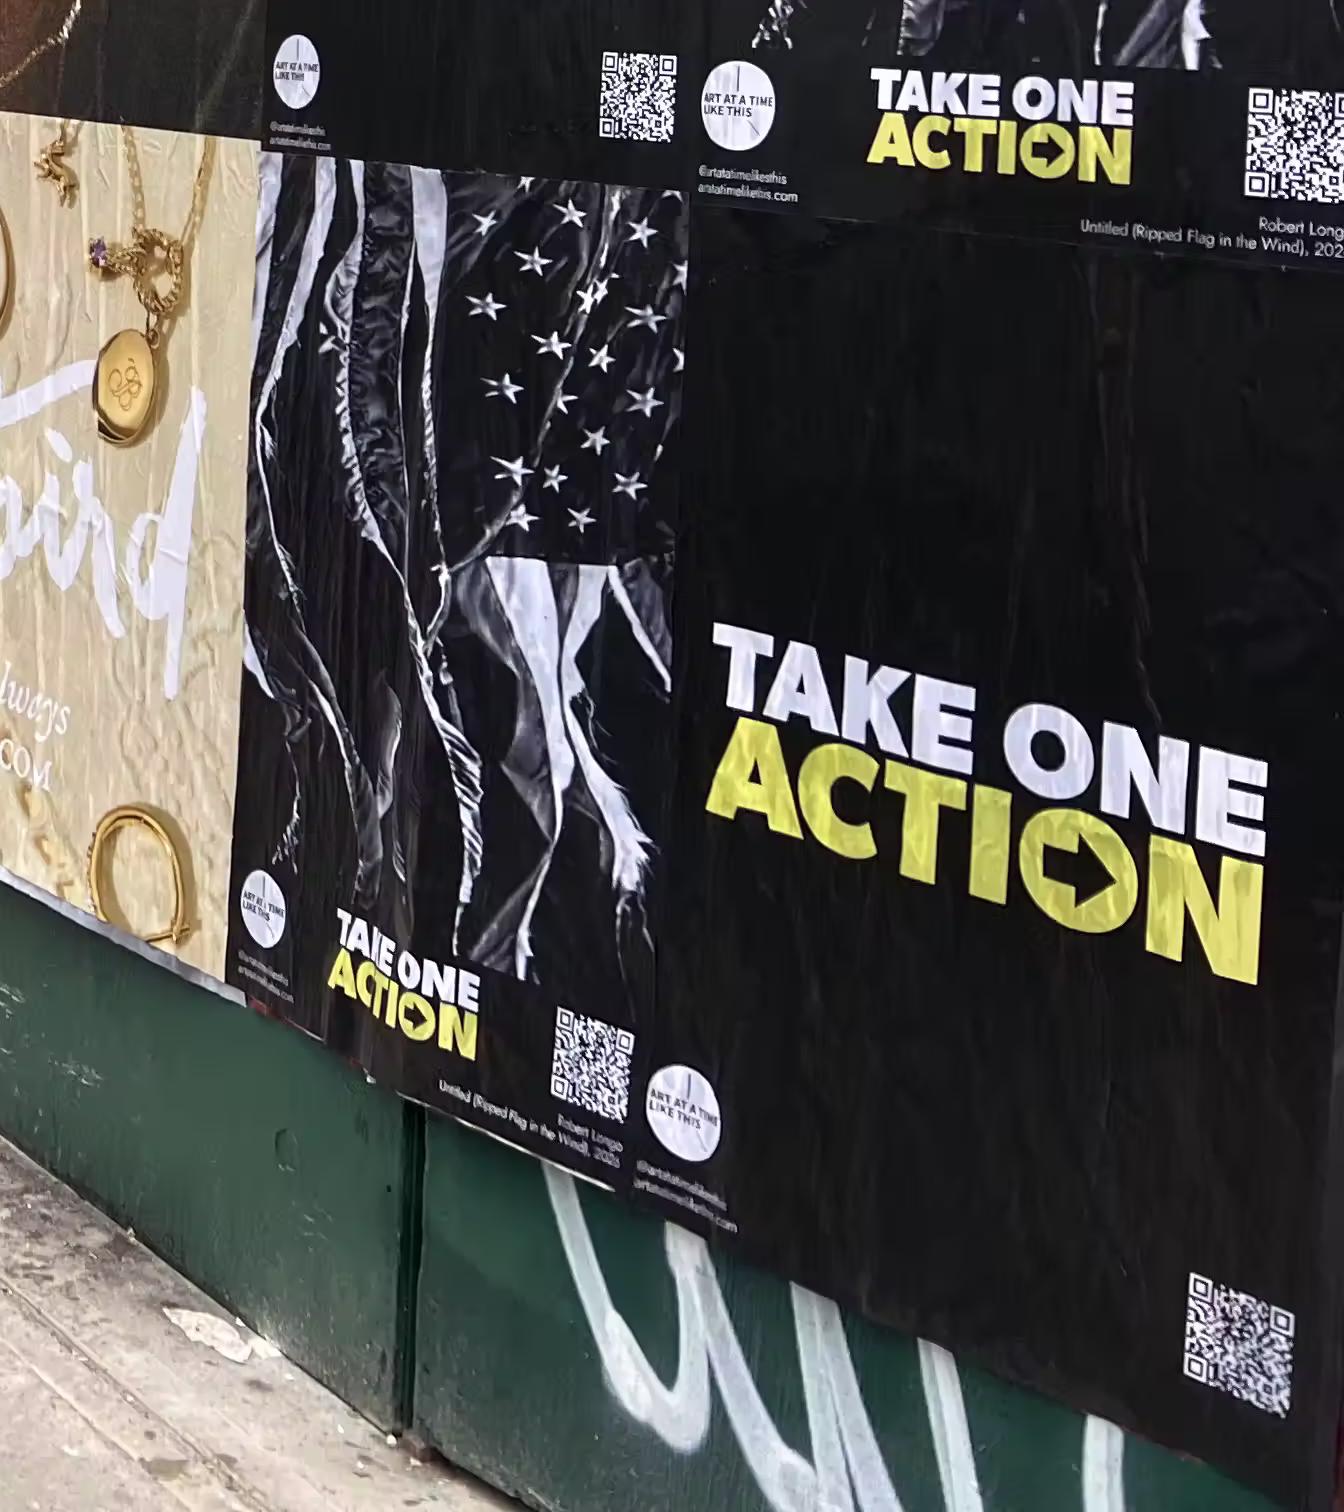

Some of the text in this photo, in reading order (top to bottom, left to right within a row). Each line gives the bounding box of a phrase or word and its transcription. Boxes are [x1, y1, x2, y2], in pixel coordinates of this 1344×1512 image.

[704, 93, 773, 107] ART AT A TIME
[704, 105, 752, 117] LIKE THIS
[870, 68, 1134, 126] TAKE ONE
[866, 112, 1132, 185] ACTION
[1080, 219, 1129, 237] Untitled
[1132, 224, 1183, 244] (Ripped
[1187, 230, 1215, 248] Flag
[1219, 232, 1232, 247] in
[1236, 233, 1257, 250] the
[1314, 241, 1344, 258] 202
[1259, 216, 1344, 242] Robert Long
[713, 621, 1268, 857] TAKE ONE
[705, 716, 1264, 986] ACTION
[328, 948, 477, 1061] ACTION
[398, 950, 480, 1012] ONE
[649, 1100, 701, 1129] LIKE THIS
[651, 1088, 672, 1104] ART
[674, 1098, 687, 1110] AT
[689, 1103, 696, 1115] A
